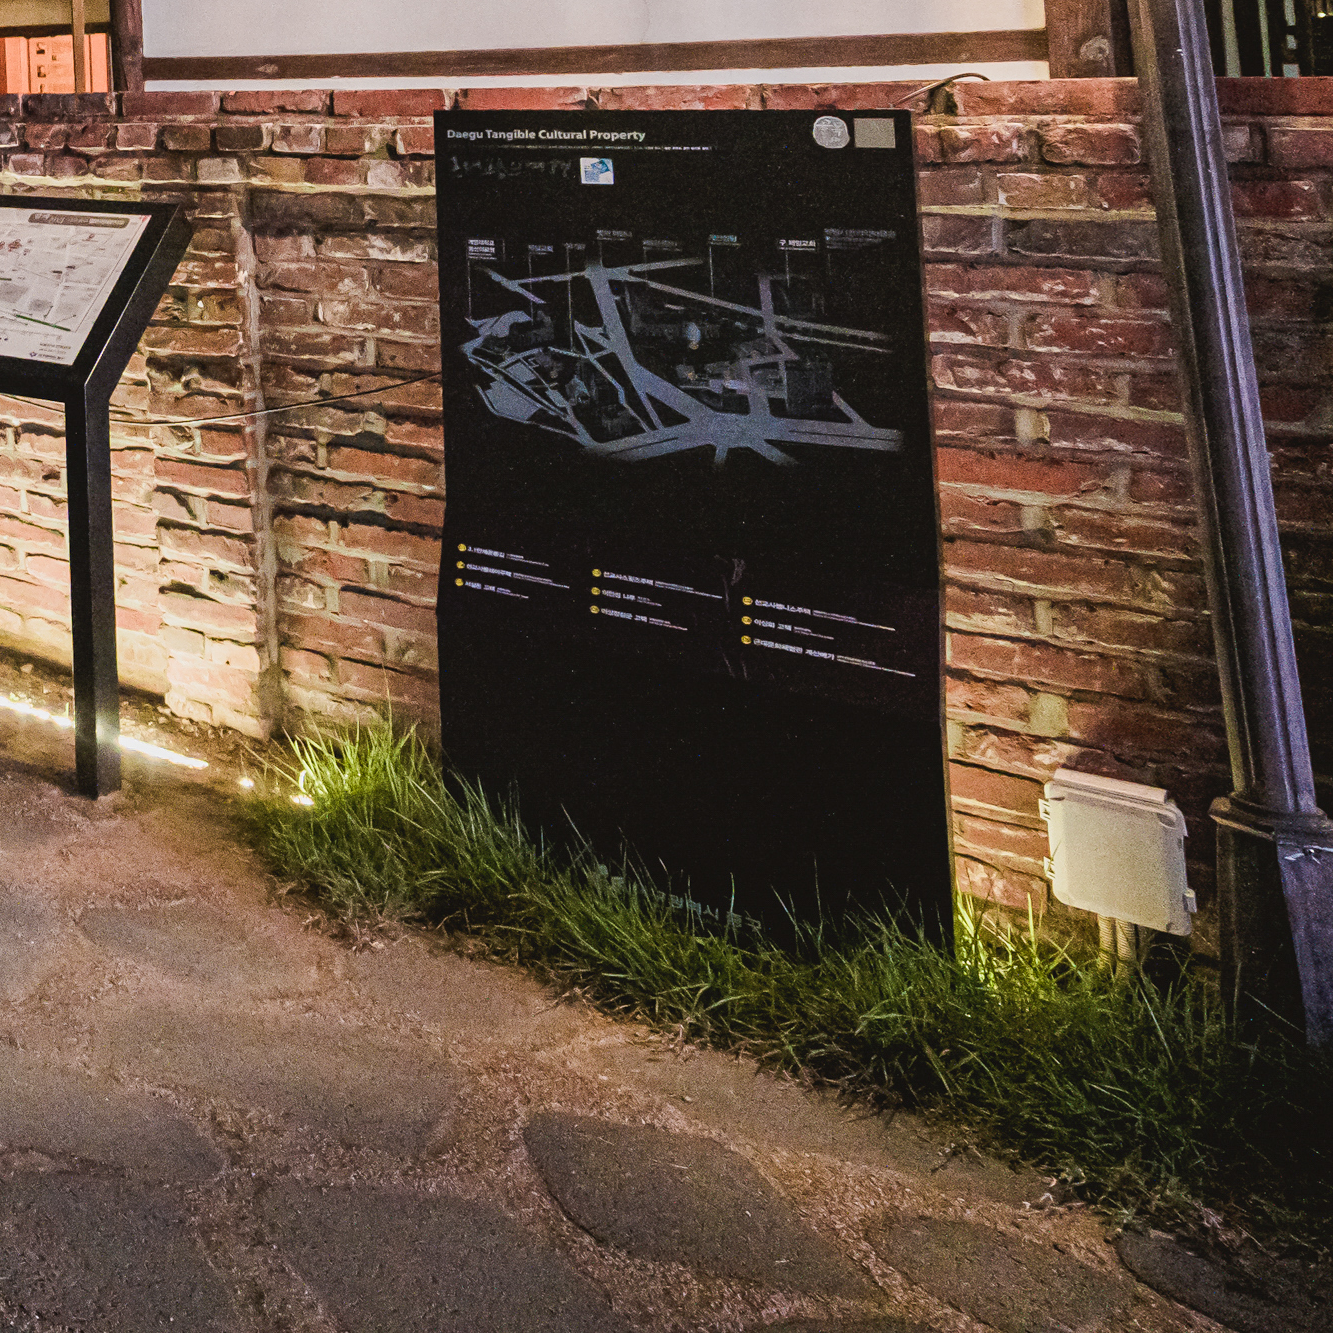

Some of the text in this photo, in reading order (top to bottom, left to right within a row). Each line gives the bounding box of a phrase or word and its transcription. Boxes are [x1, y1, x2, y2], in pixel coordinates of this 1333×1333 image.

[447, 129, 647, 142] Daegu Tangible Cultural Property
